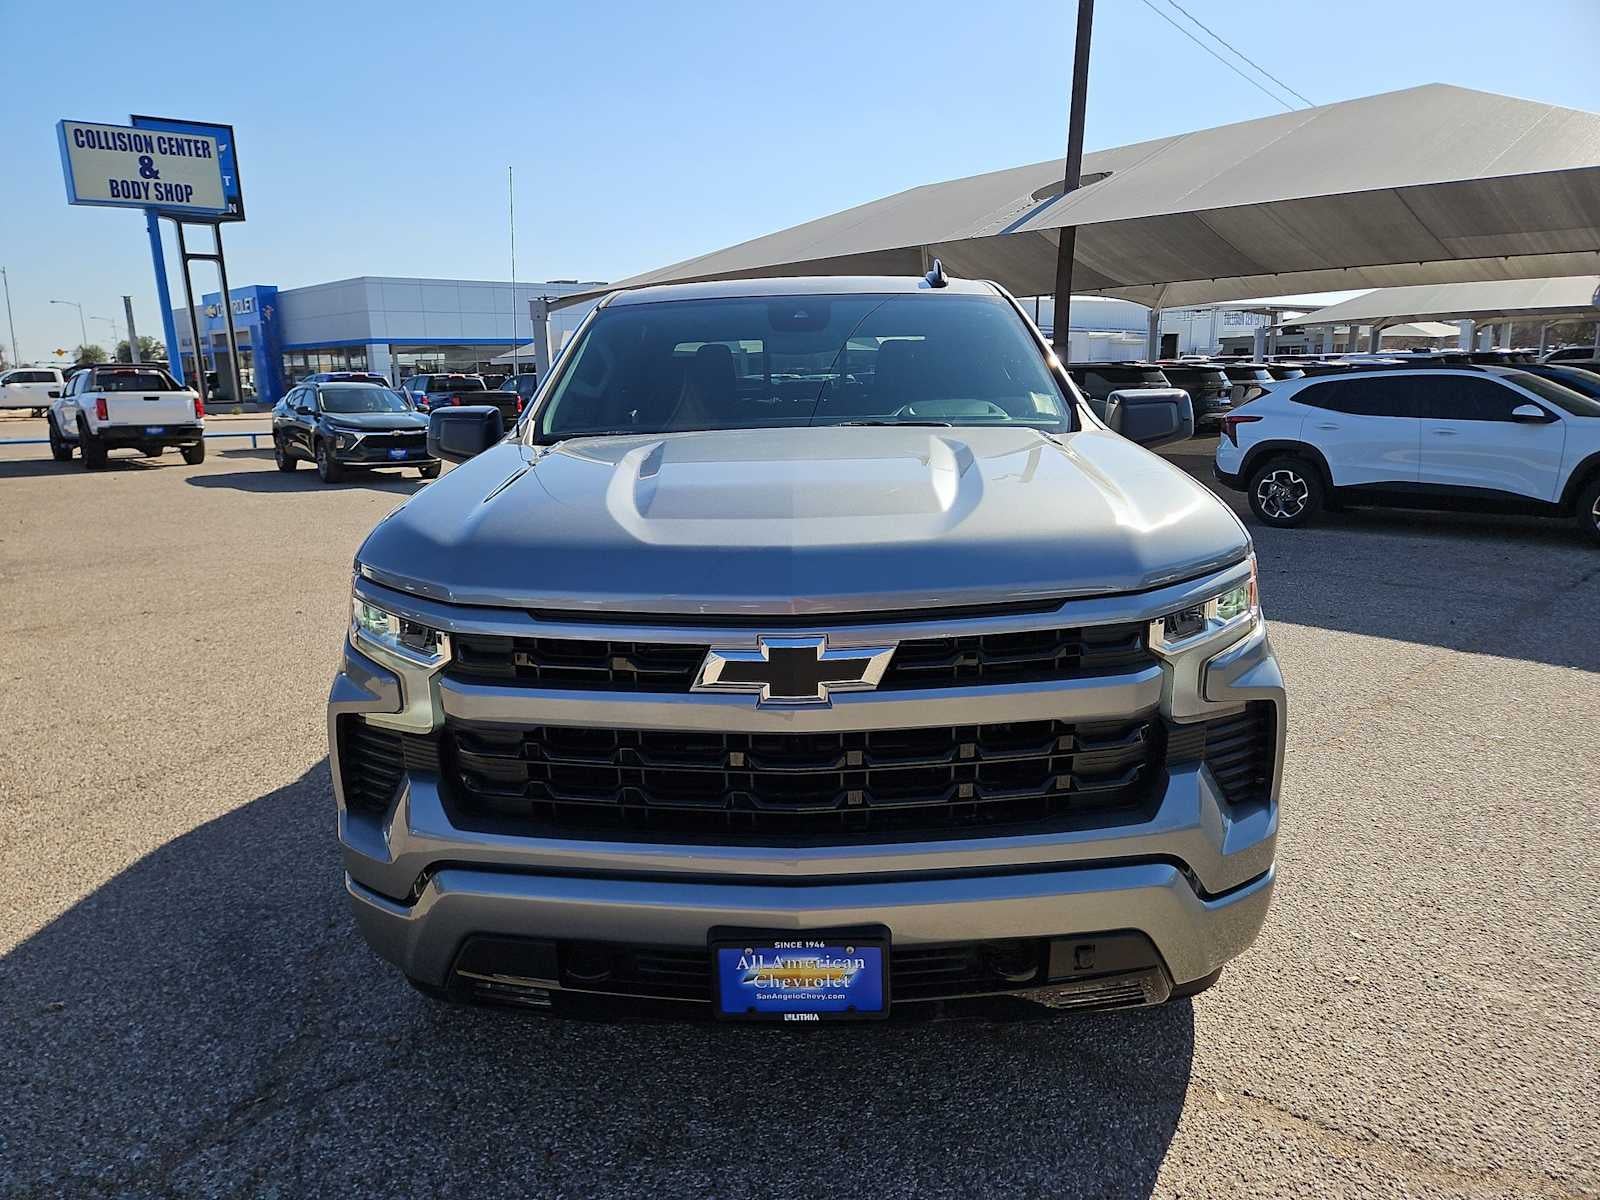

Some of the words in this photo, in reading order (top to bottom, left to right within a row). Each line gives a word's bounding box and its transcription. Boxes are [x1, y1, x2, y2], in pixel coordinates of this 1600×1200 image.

[73, 128, 154, 153] COLLISION
[157, 136, 212, 159] CENTER
[138, 155, 160, 180] &
[109, 179, 151, 201] BODY
[154, 182, 193, 203] SHOP
[774, 941, 802, 949] SINCE
[805, 941, 825, 949] 1946
[735, 954, 763, 970] All
[772, 954, 865, 970] American
[753, 974, 850, 989] Chevrolet
[756, 992, 846, 1001] SanAngeloChevy.com
[792, 1013, 820, 1021] LITHIA
